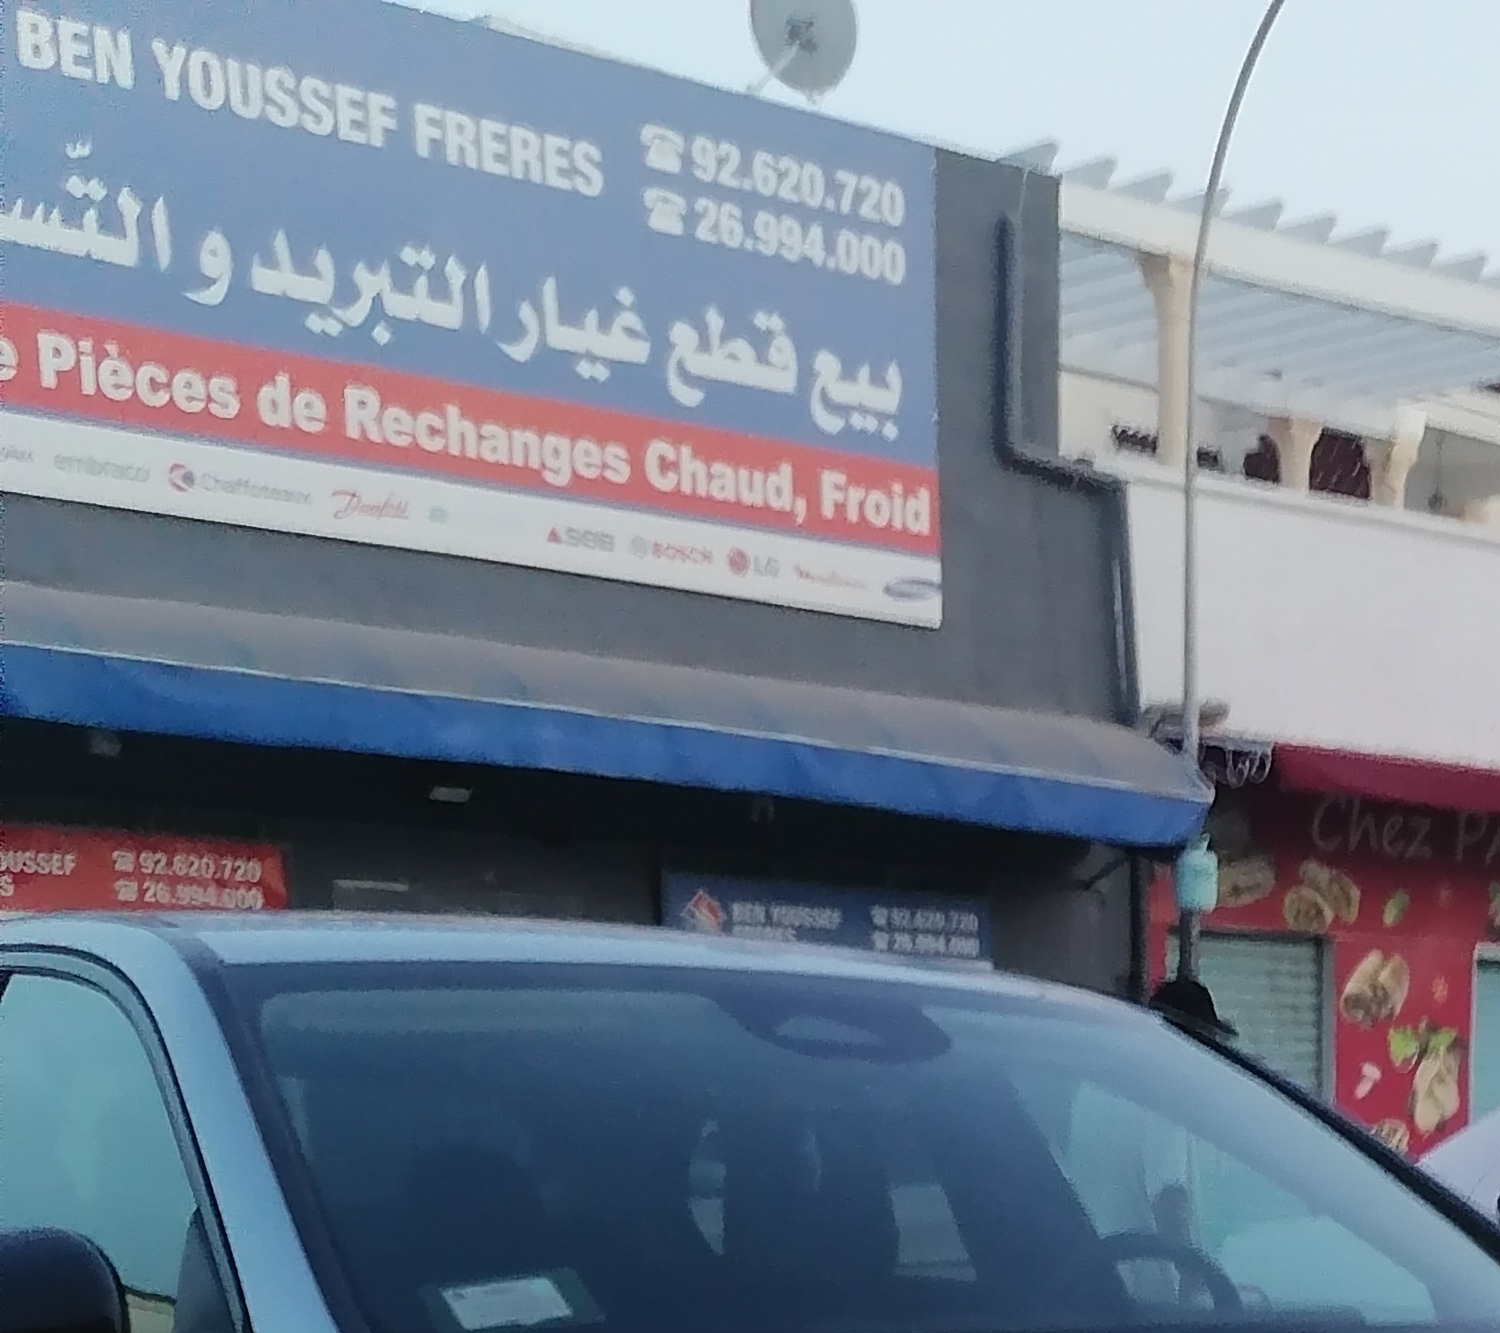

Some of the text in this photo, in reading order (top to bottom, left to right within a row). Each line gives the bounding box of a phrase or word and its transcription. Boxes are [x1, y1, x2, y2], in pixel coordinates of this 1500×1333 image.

[15, 8, 604, 198] BEN YOUSSEF FRERES
[691, 135, 905, 227] 92.620.720
[183, 227, 233, 306] و
[250, 228, 491, 347] التبريد
[693, 197, 906, 286] 26.994.000
[496, 273, 652, 383] غيار
[667, 303, 799, 407] قطع
[37, 329, 241, 419] Pièces
[257, 371, 327, 434] de
[343, 381, 632, 488] Rechanges
[644, 438, 808, 526] Chaud,
[820, 467, 931, 537] Froid
[810, 349, 901, 442] بيع
[140, 852, 262, 883] 92.620.720
[1311, 795, 1434, 861] Chez
